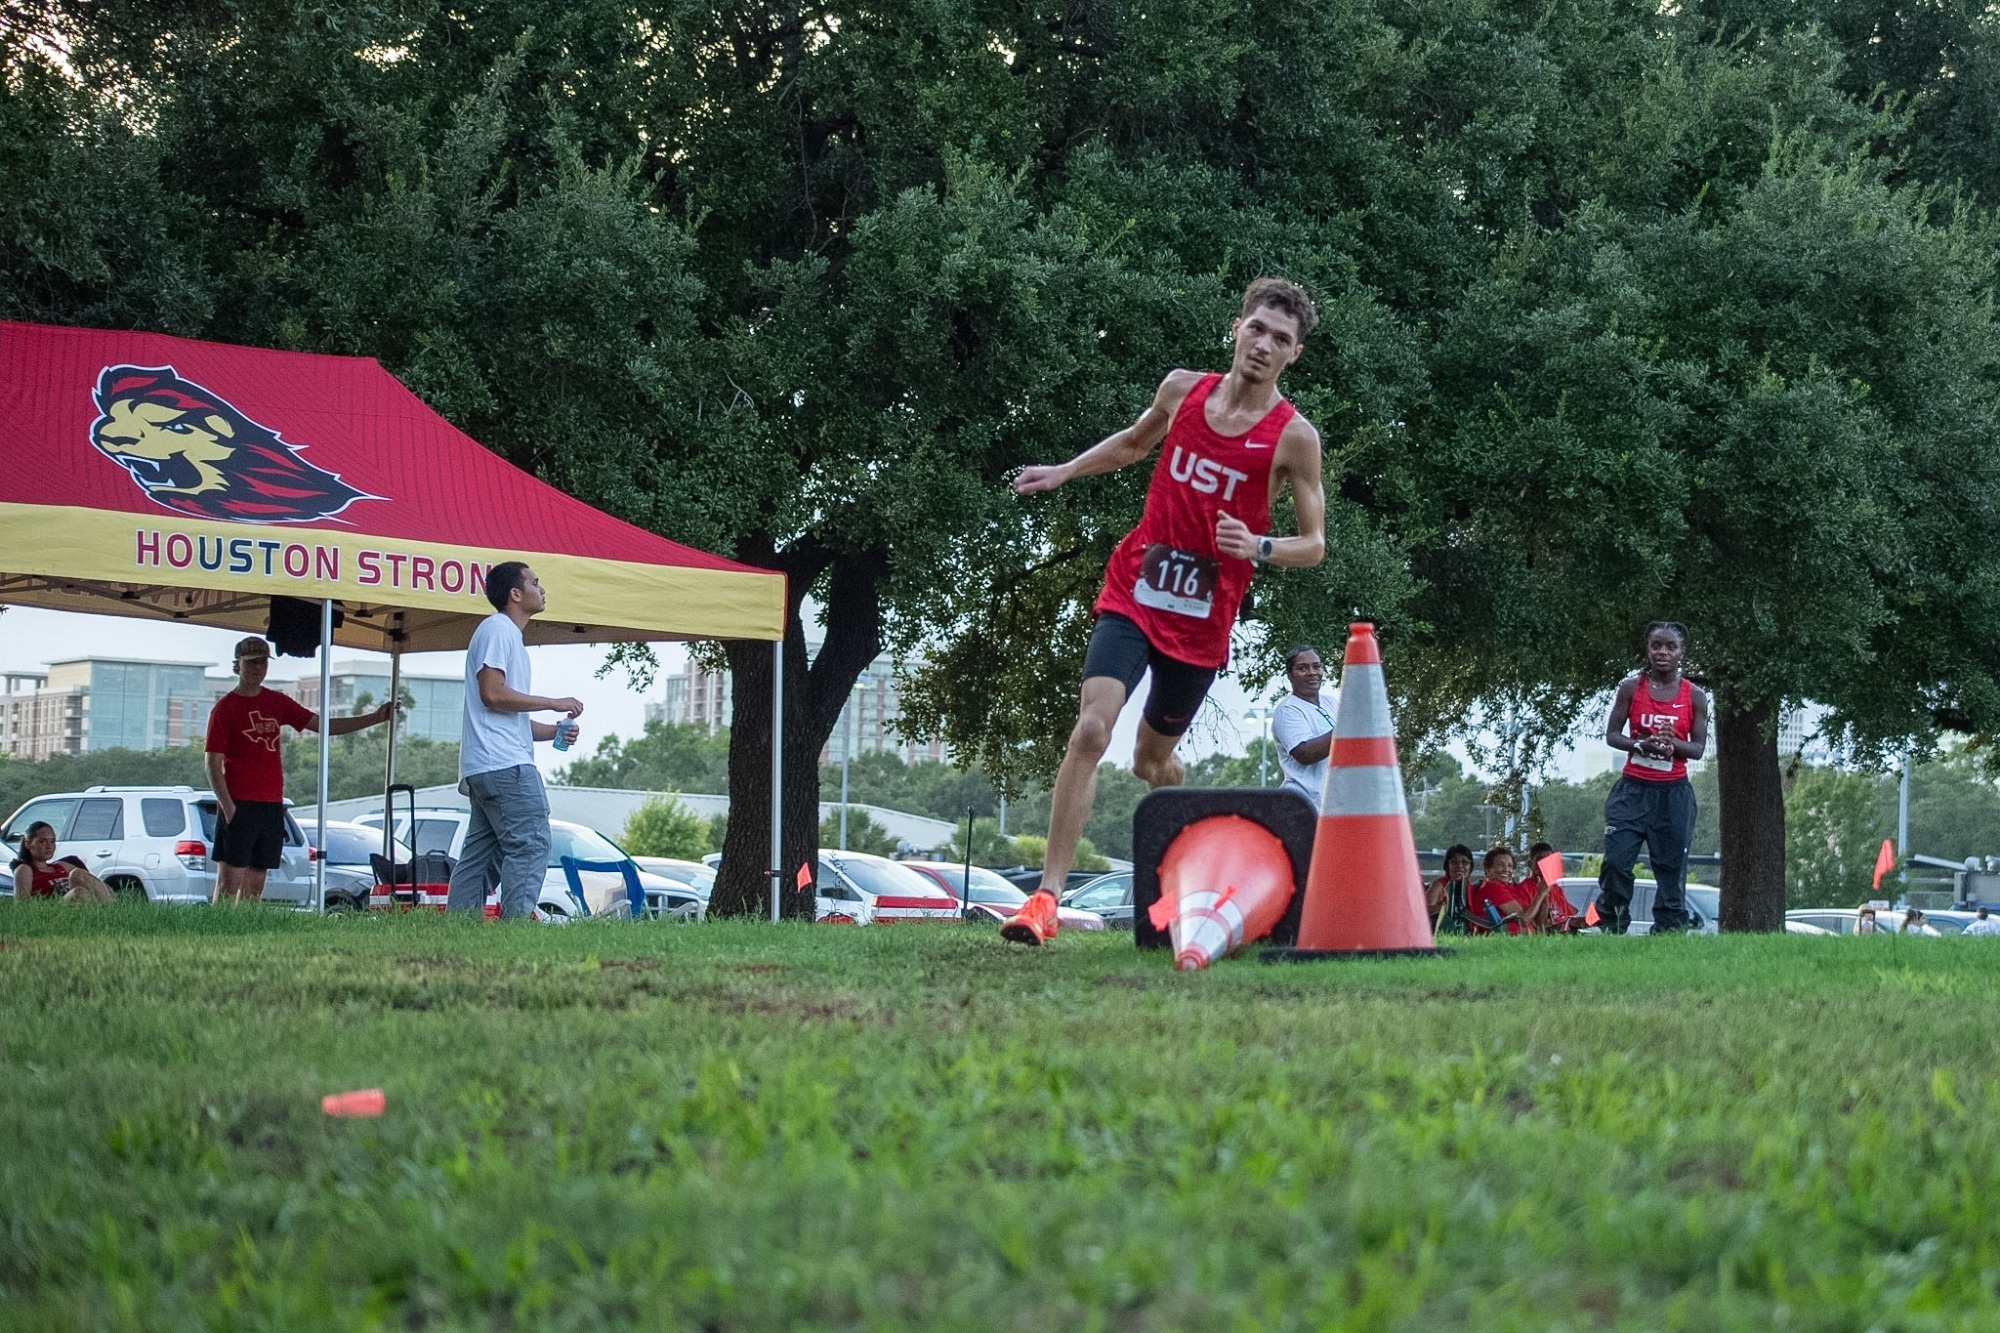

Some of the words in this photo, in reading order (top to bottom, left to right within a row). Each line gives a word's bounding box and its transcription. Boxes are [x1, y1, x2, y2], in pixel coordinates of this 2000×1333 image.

[1169, 445, 1248, 502] UST
[135, 529, 340, 582] HOUSTON
[357, 550, 493, 598] STRON
[1158, 559, 1199, 596] 116
[1640, 713, 1679, 730] UST
